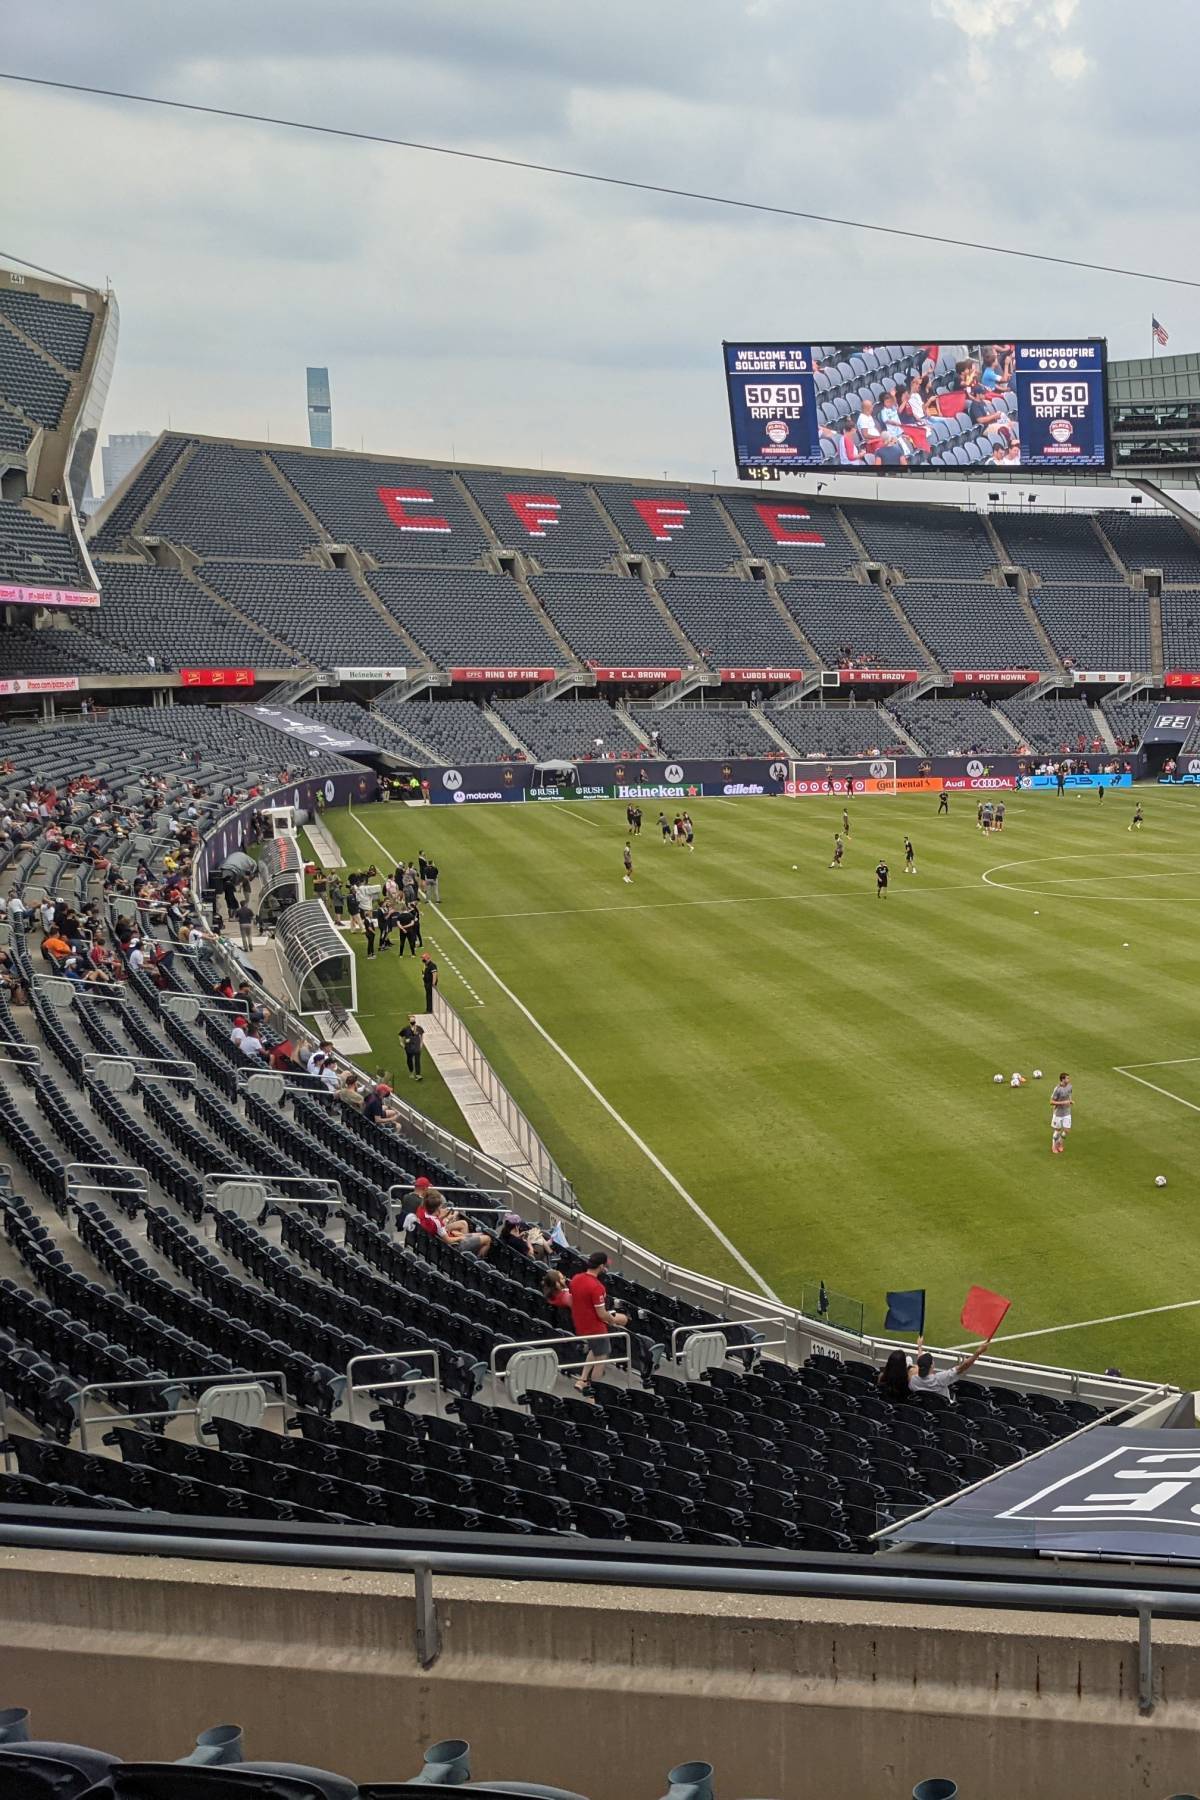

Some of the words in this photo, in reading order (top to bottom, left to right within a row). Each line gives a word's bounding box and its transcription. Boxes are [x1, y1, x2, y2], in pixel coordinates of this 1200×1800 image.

[737, 351, 786, 360] WELCOME
[789, 351, 802, 360] TO
[735, 361, 779, 370] SOLDIER
[780, 361, 807, 370] FIELD
[751, 407, 801, 419] RAFFLE
[1035, 406, 1085, 418] RAFFLE
[748, 467, 778, 480] 4:51
[377, 487, 451, 532] C
[504, 492, 561, 537] F
[632, 499, 690, 541] F
[755, 503, 826, 547] C
[349, 671, 383, 679] Heineken
[638, 671, 667, 679] BROWN
[978, 673, 999, 681] PIOTR
[1001, 673, 1027, 681] NOWAK
[945, 780, 966, 788] Audi
[537, 788, 559, 796] RUSH
[583, 786, 604, 794] RUSH
[618, 785, 684, 798] Heineken
[723, 784, 764, 795] Gillette
[466, 791, 502, 800] motorola
